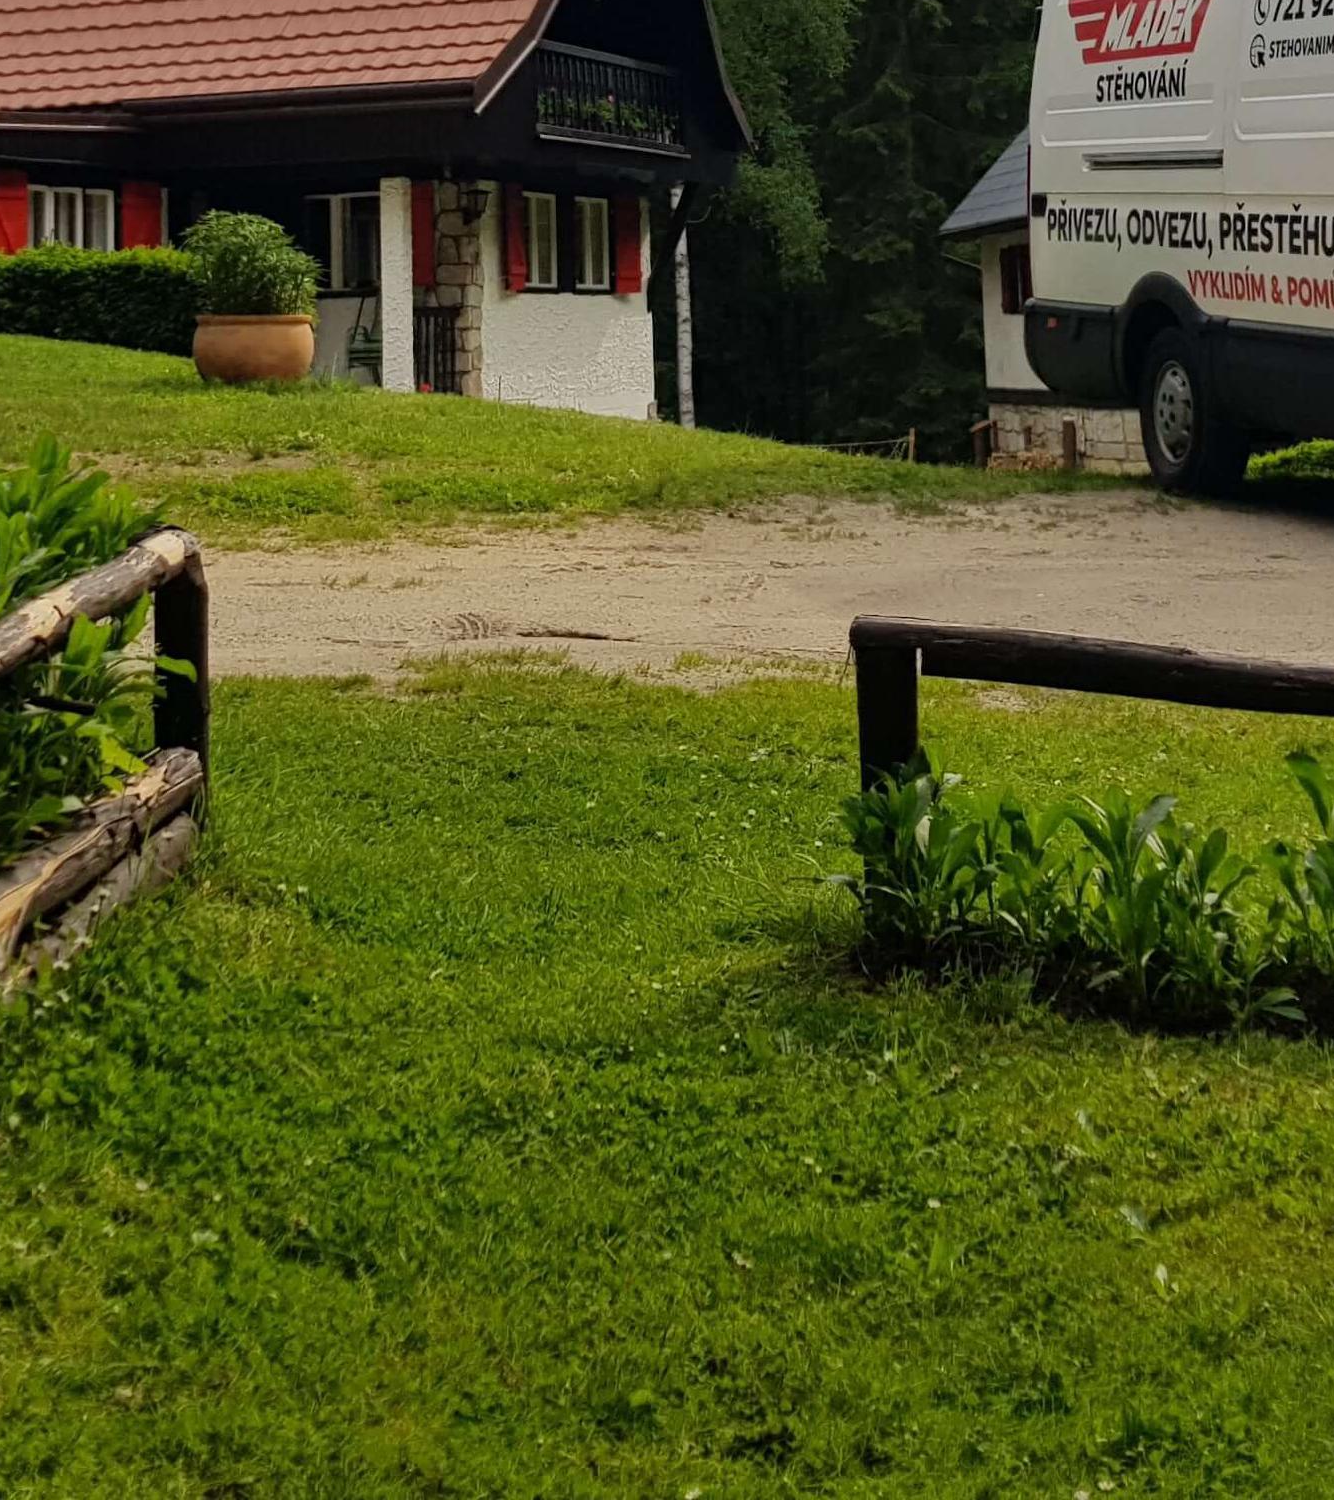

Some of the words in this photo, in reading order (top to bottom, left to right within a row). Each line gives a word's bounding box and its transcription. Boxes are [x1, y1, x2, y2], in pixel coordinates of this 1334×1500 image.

[1095, 58, 1189, 103] STĚHOVÁNÍ
[1047, 199, 1122, 253] PŘIVEZU,
[1126, 208, 1214, 260] ODVEZU,
[1187, 264, 1268, 303] VYKLIDÍM
[1270, 275, 1284, 306] &
